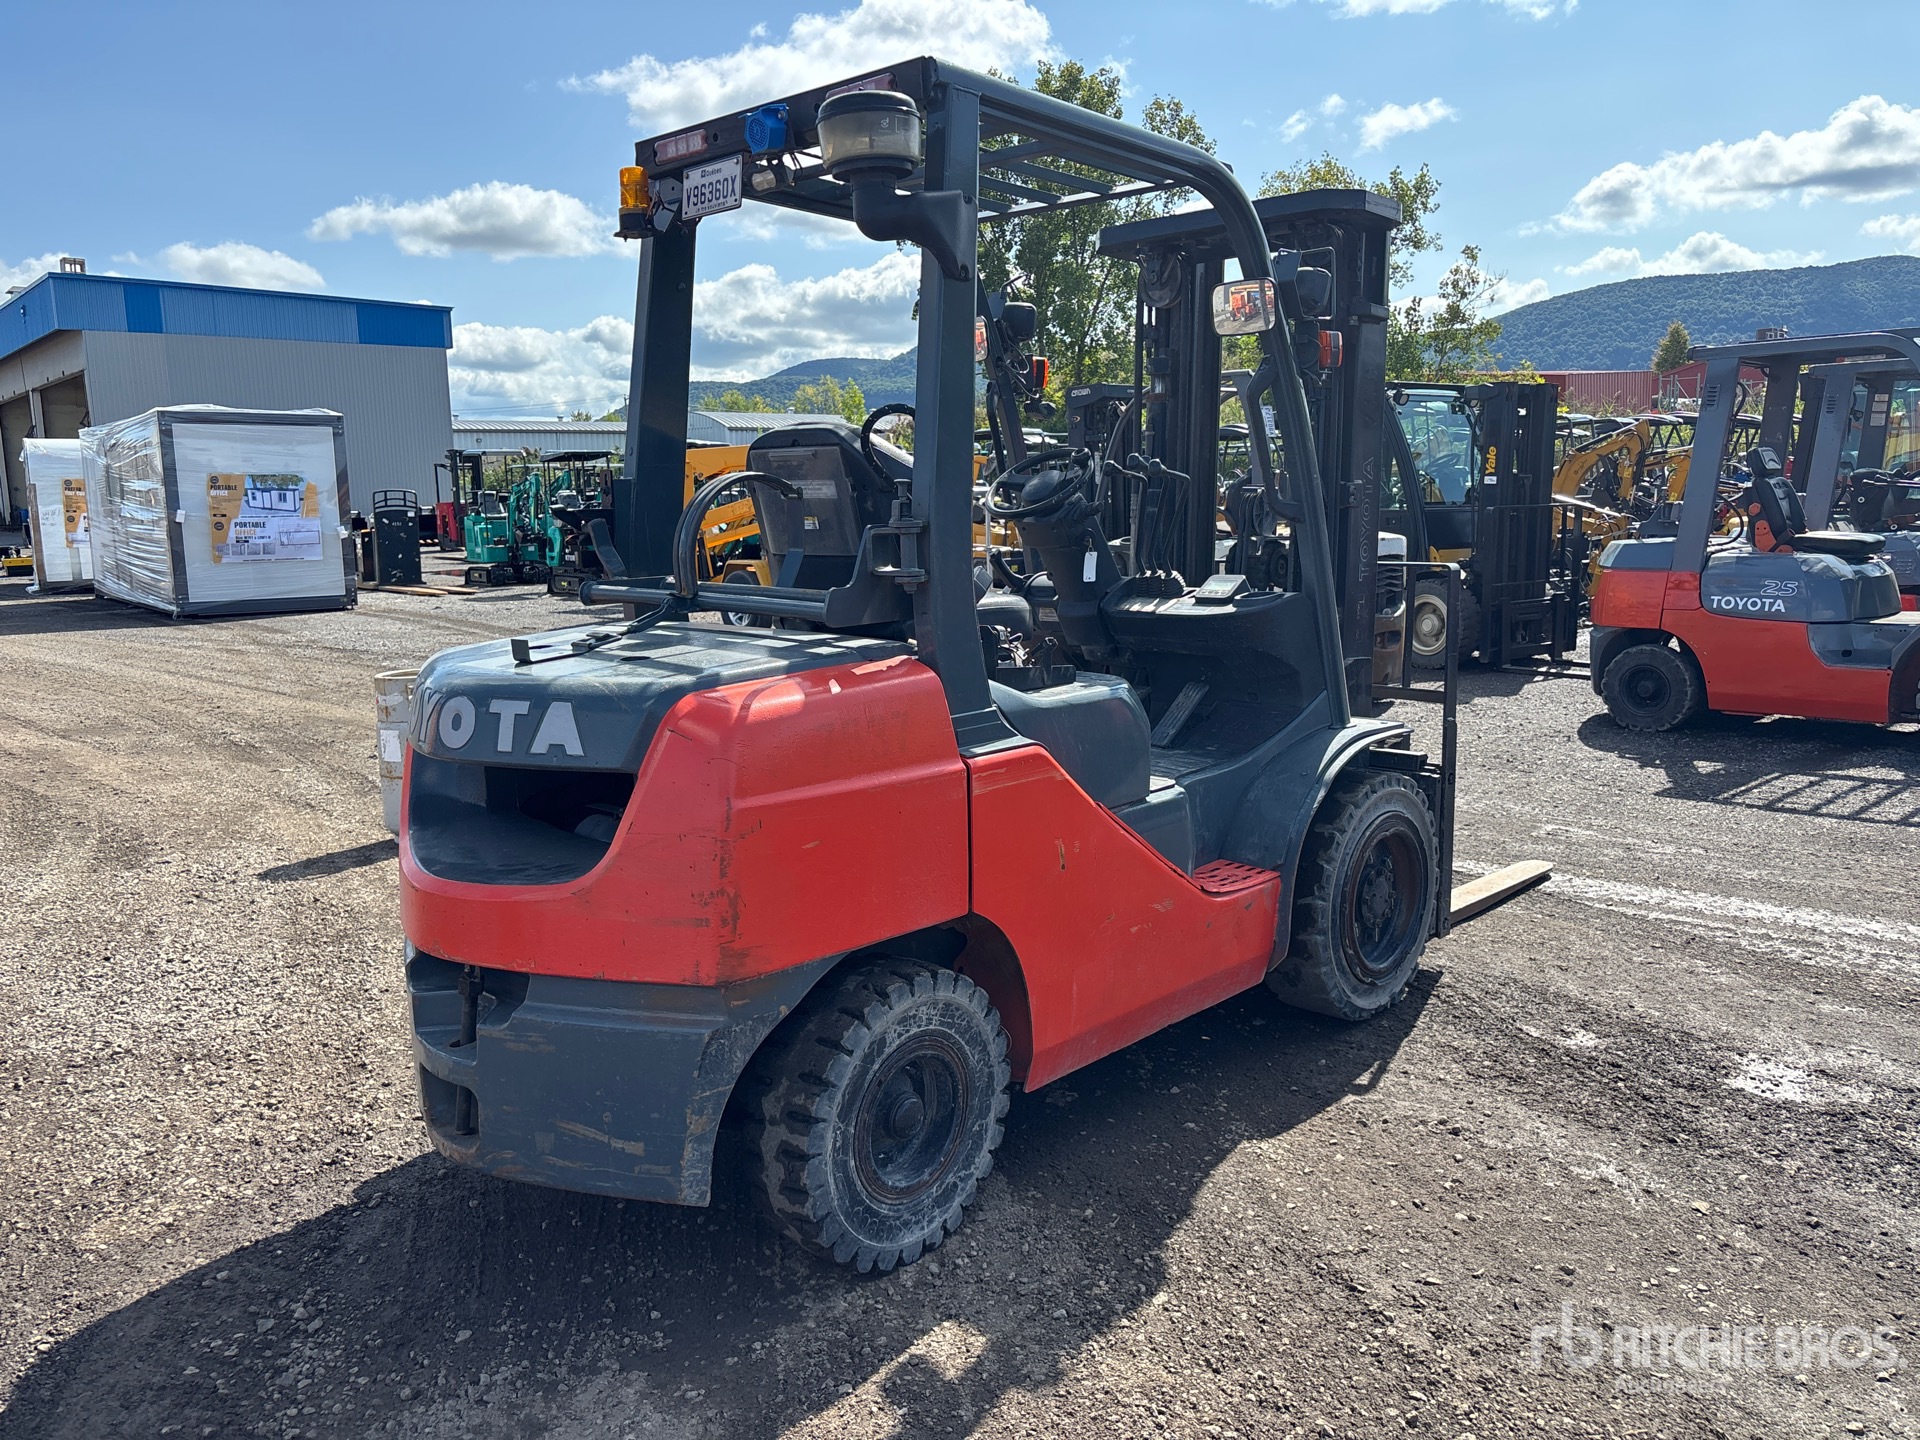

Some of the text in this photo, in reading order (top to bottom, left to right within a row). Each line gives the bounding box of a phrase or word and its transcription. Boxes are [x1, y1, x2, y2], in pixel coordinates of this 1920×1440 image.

[686, 174, 737, 208] V96360X
[1485, 446, 1497, 474] Yale
[234, 521, 267, 529] PORTABLE
[1359, 457, 1374, 581] TOYOTA
[1760, 580, 1799, 596] 25
[1710, 596, 1786, 613] TOYOTA
[410, 682, 585, 756] YOTA
